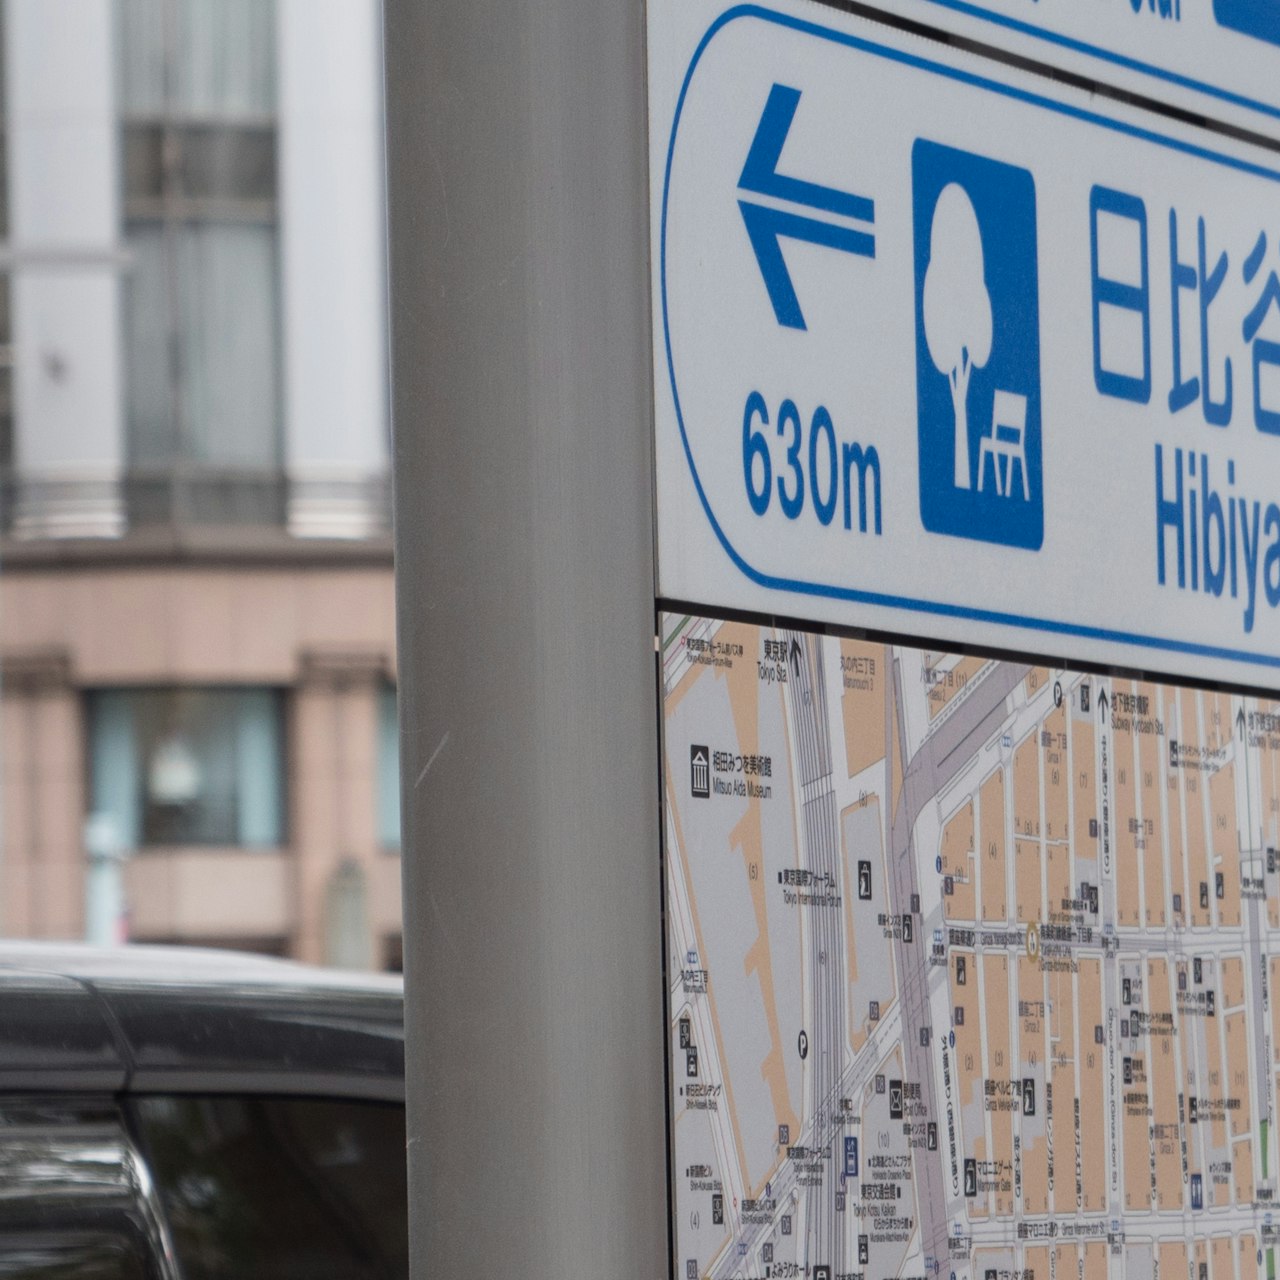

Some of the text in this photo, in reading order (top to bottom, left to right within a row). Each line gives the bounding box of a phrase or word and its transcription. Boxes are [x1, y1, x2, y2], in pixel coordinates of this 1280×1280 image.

[742, 390, 883, 536] 630m
[764, 640, 788, 664] 東京駅
[757, 661, 776, 681] Tokyo
[713, 750, 771, 778] 相田みつを美術館
[713, 778, 772, 799] Mitsuo Aida Museum
[783, 868, 835, 889] 東京国際フォーラム
